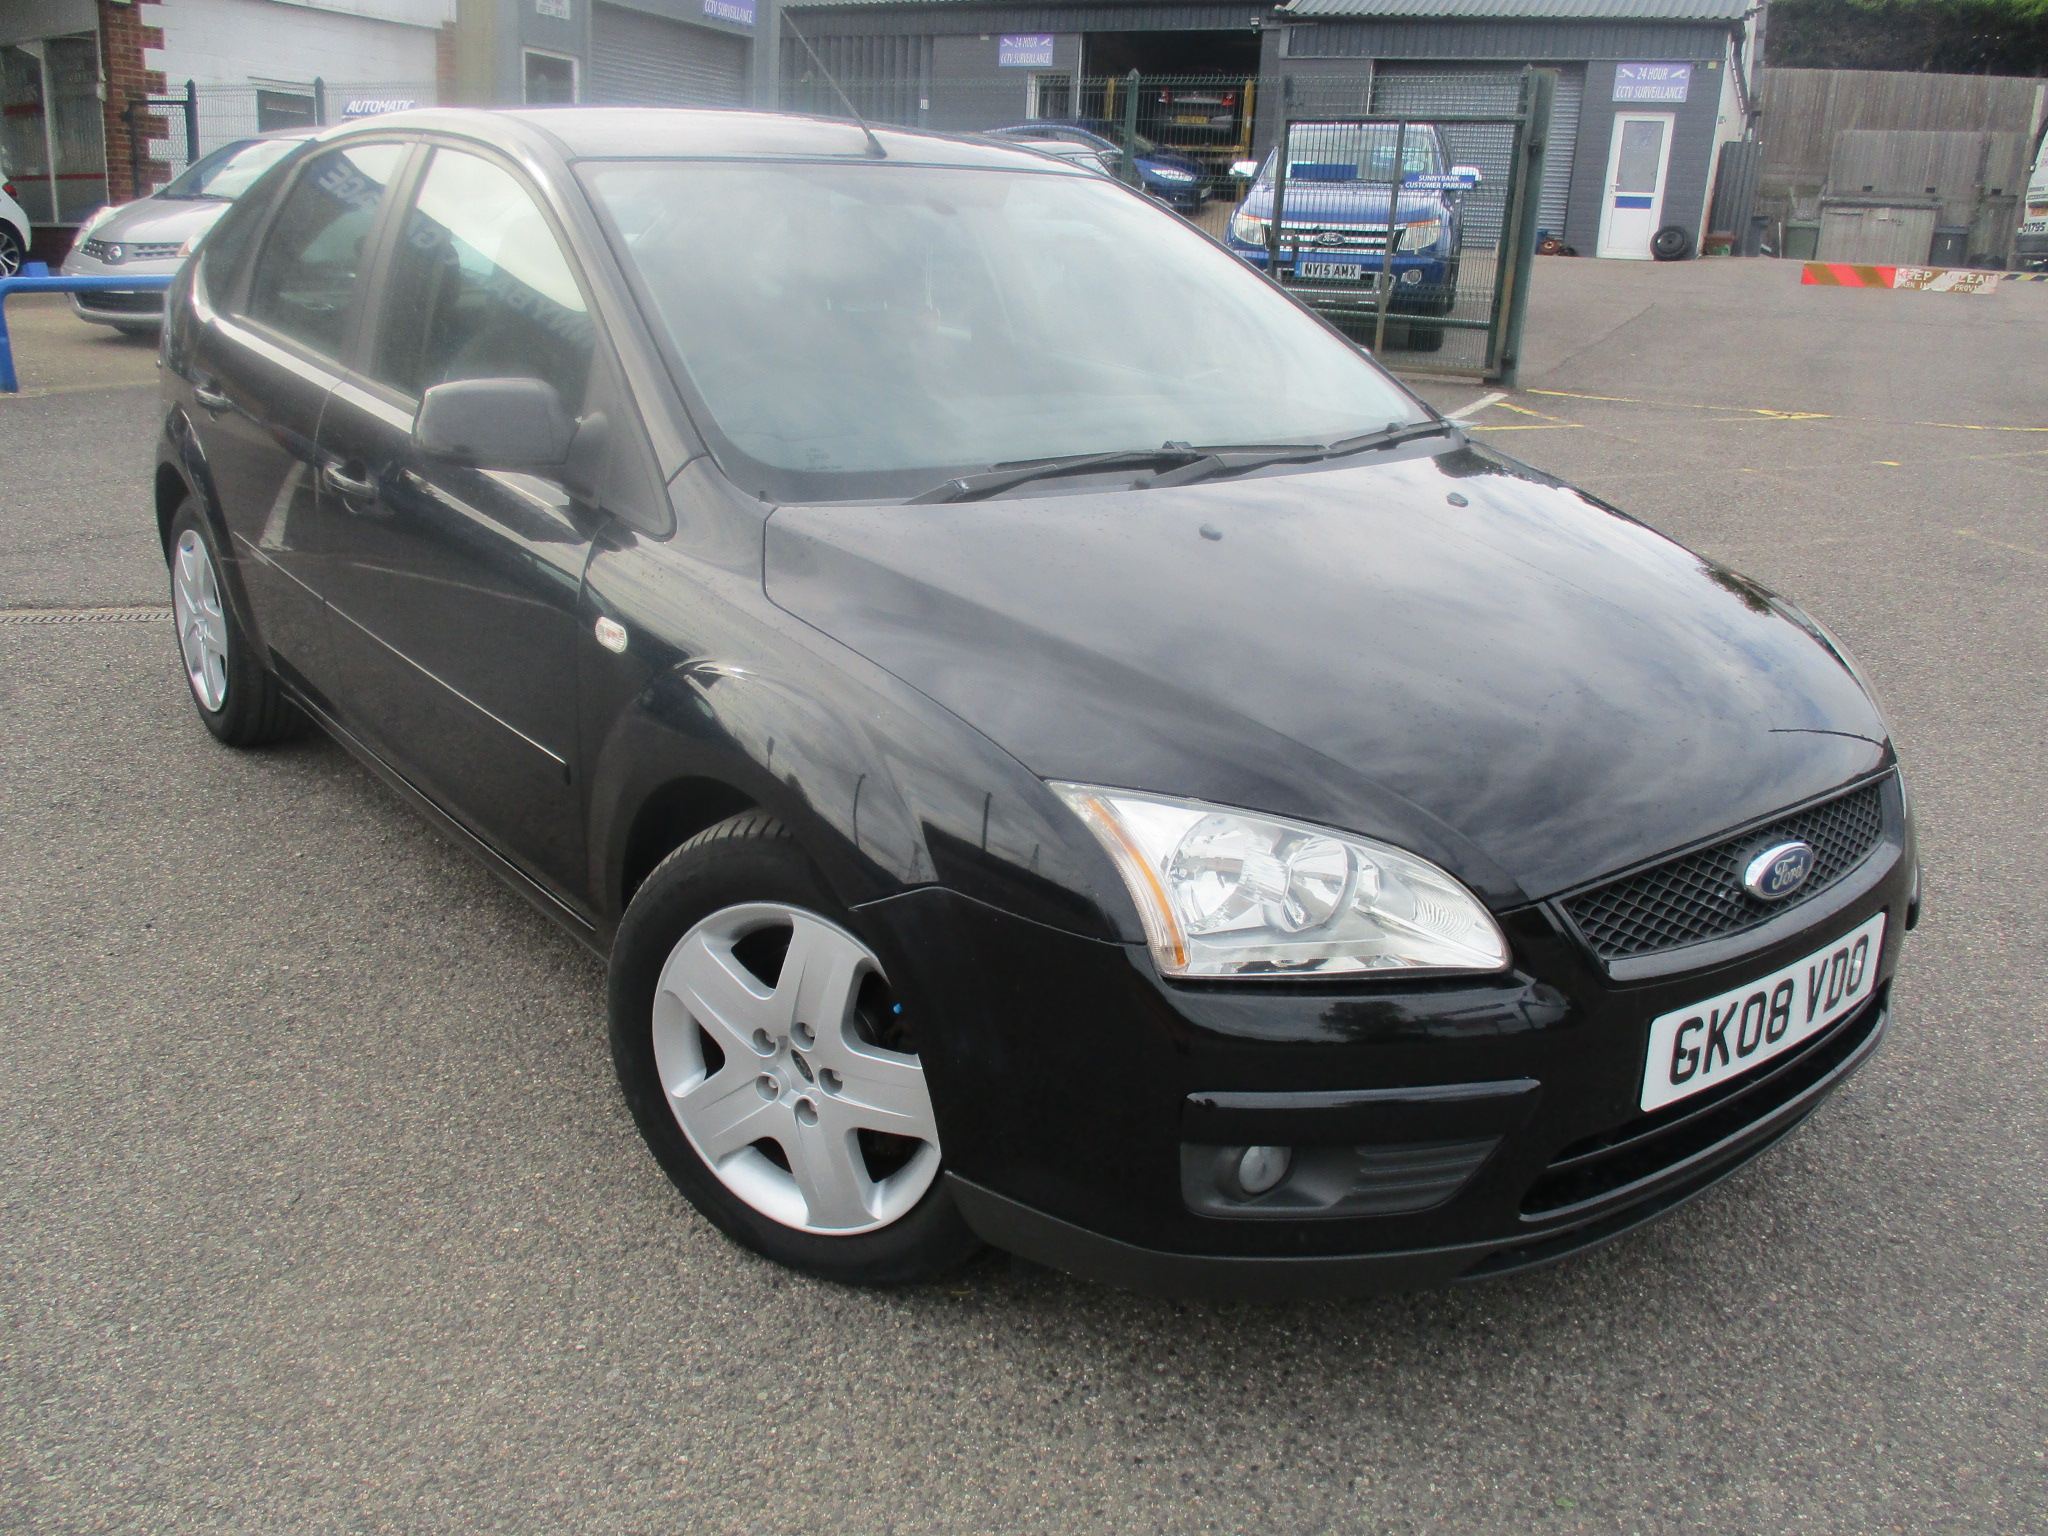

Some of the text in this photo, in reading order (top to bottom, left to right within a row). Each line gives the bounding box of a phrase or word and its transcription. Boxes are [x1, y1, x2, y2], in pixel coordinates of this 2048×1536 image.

[1014, 37, 1037, 47] 24 HOUR
[1001, 53, 1050, 64] CCTV SURVEILLANCE
[1637, 68, 1669, 80] 24 HOUR
[1616, 86, 1685, 99] CCTV SURVEILLANCE
[346, 101, 415, 113] AUTOMATIC
[2023, 222, 2047, 232] 01795
[1304, 263, 1331, 276] NY15
[1771, 855, 1805, 890] Ford
[1669, 934, 1869, 1086] GK08 VDO
